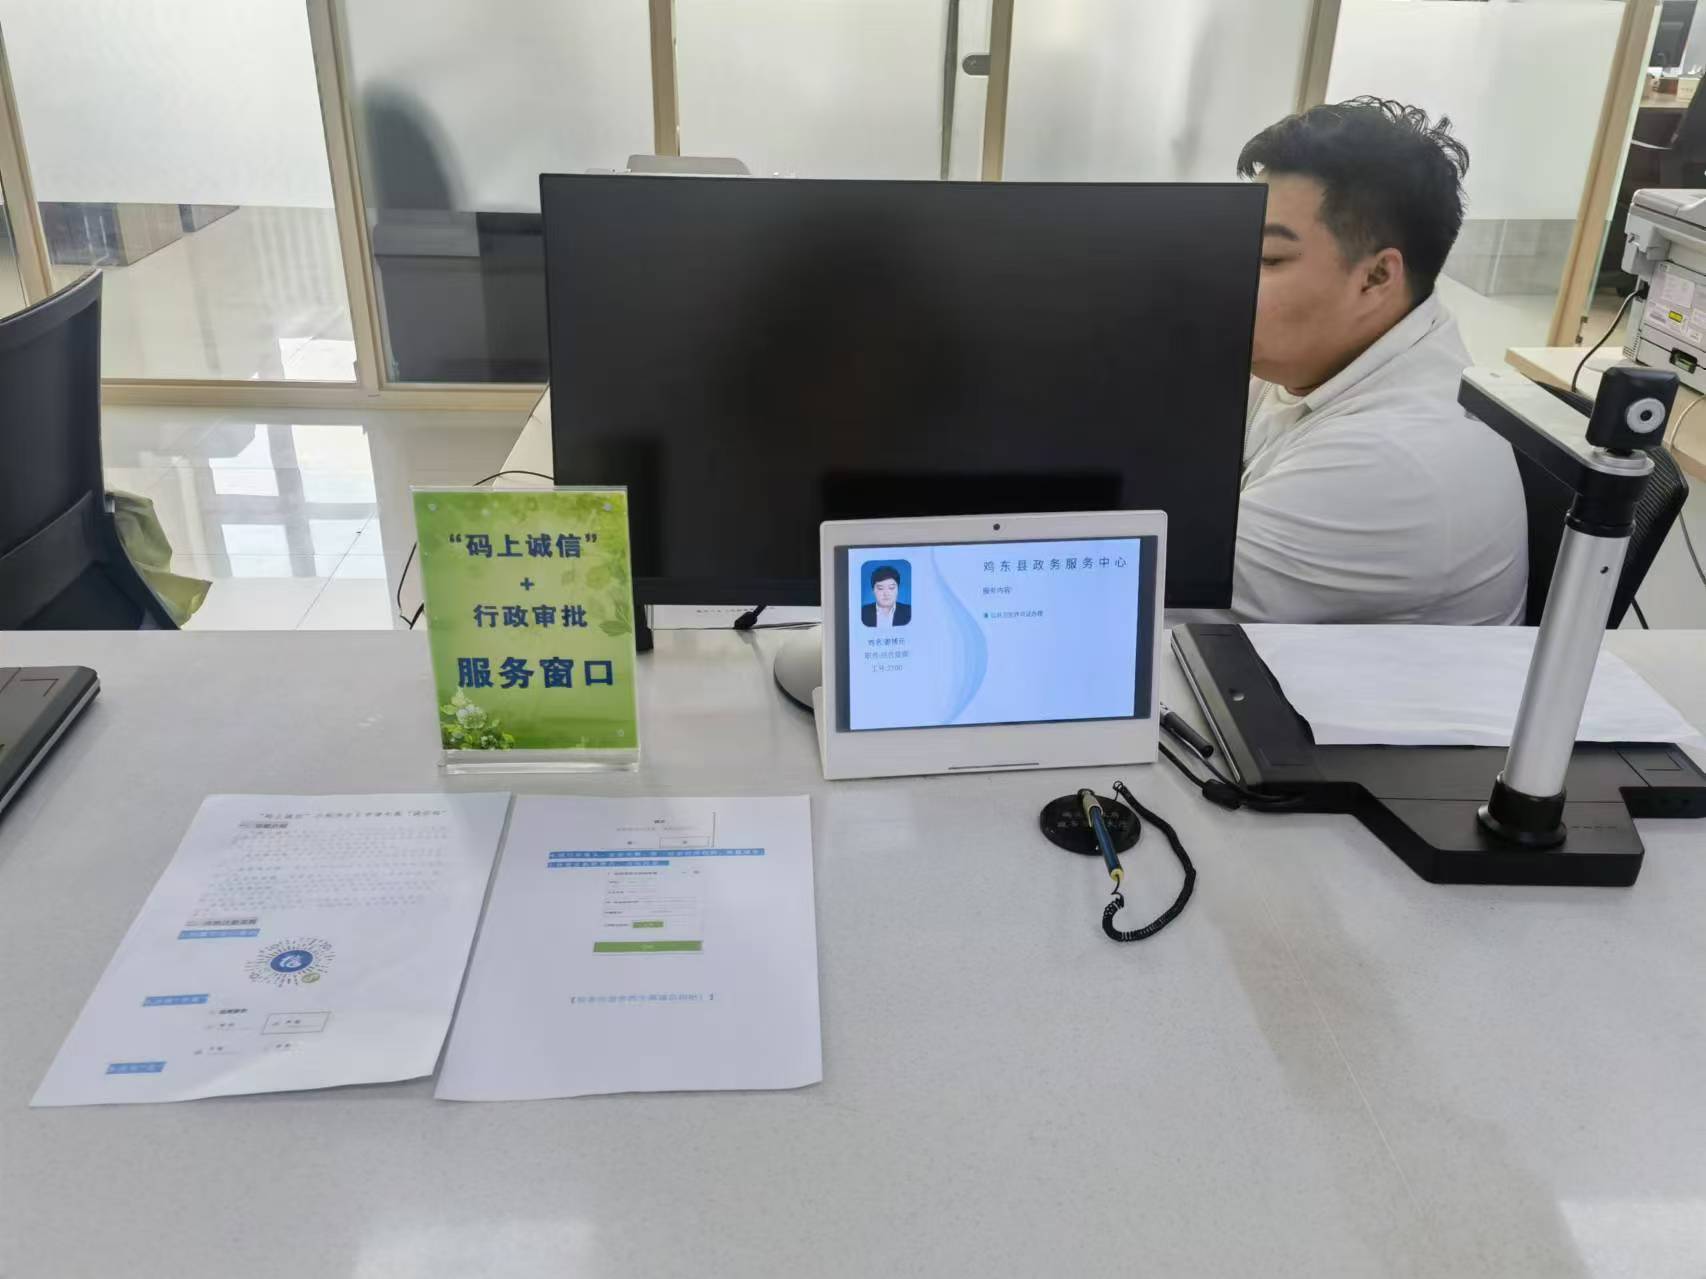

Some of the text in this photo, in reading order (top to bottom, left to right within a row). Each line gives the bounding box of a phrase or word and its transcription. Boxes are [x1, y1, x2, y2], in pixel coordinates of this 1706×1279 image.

[983, 556, 1127, 573] 鸡东县政务服务中心
[473, 604, 588, 629] 行政审批
[457, 657, 614, 689] 服务窗口
